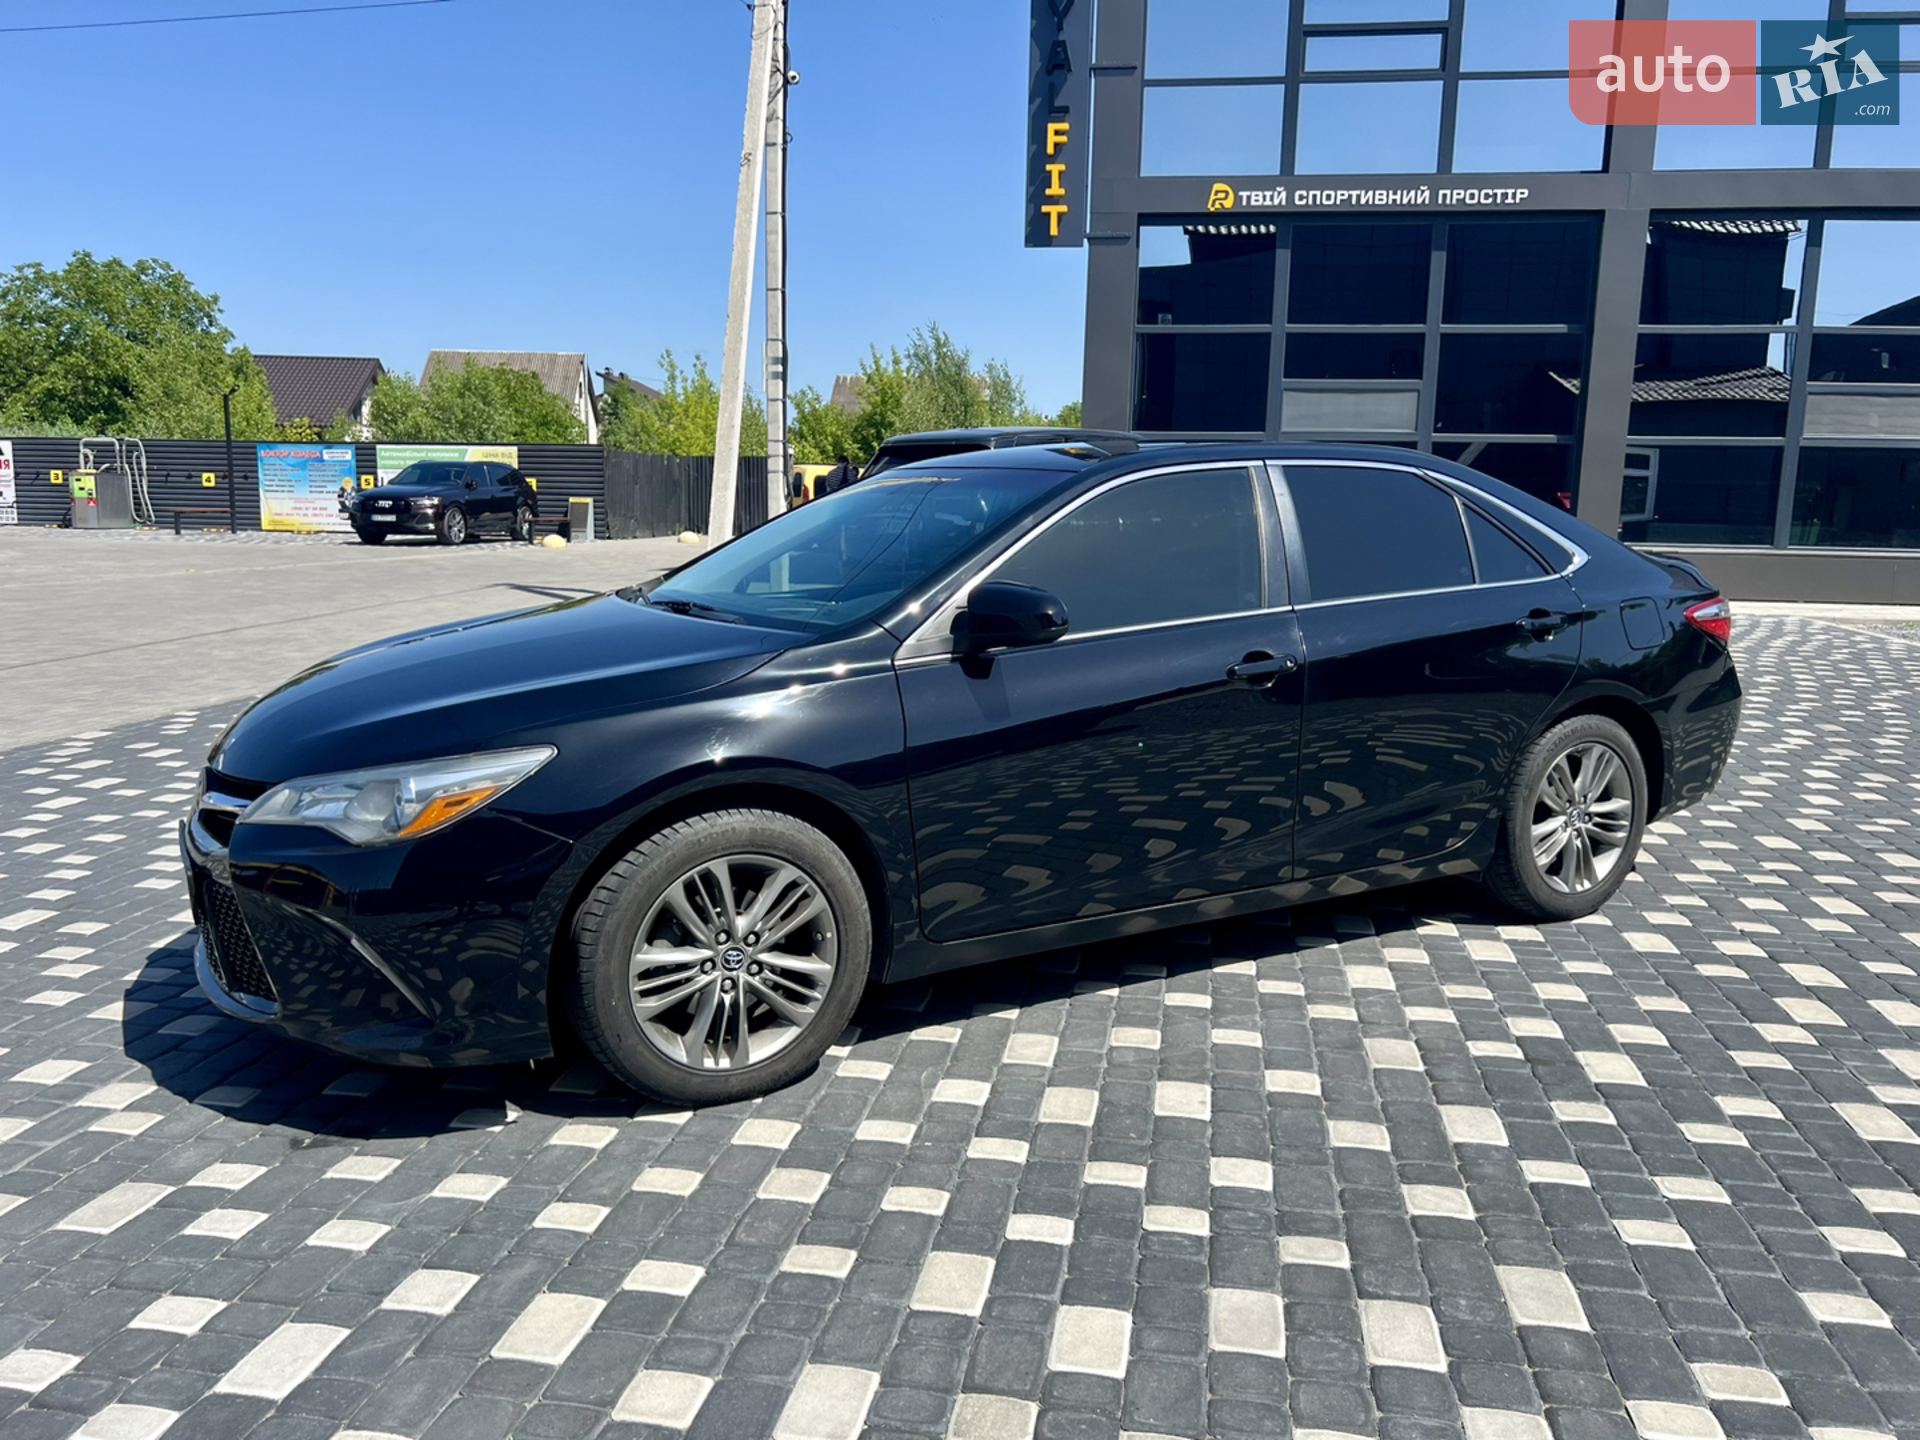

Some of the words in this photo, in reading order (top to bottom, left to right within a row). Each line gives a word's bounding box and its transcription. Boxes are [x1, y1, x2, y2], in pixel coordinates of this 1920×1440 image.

[1238, 187, 1286, 206] ТВІЙ
[1294, 186, 1430, 206] СПОРТИВНИЙ
[1437, 188, 1529, 205] ПРОСТІР
